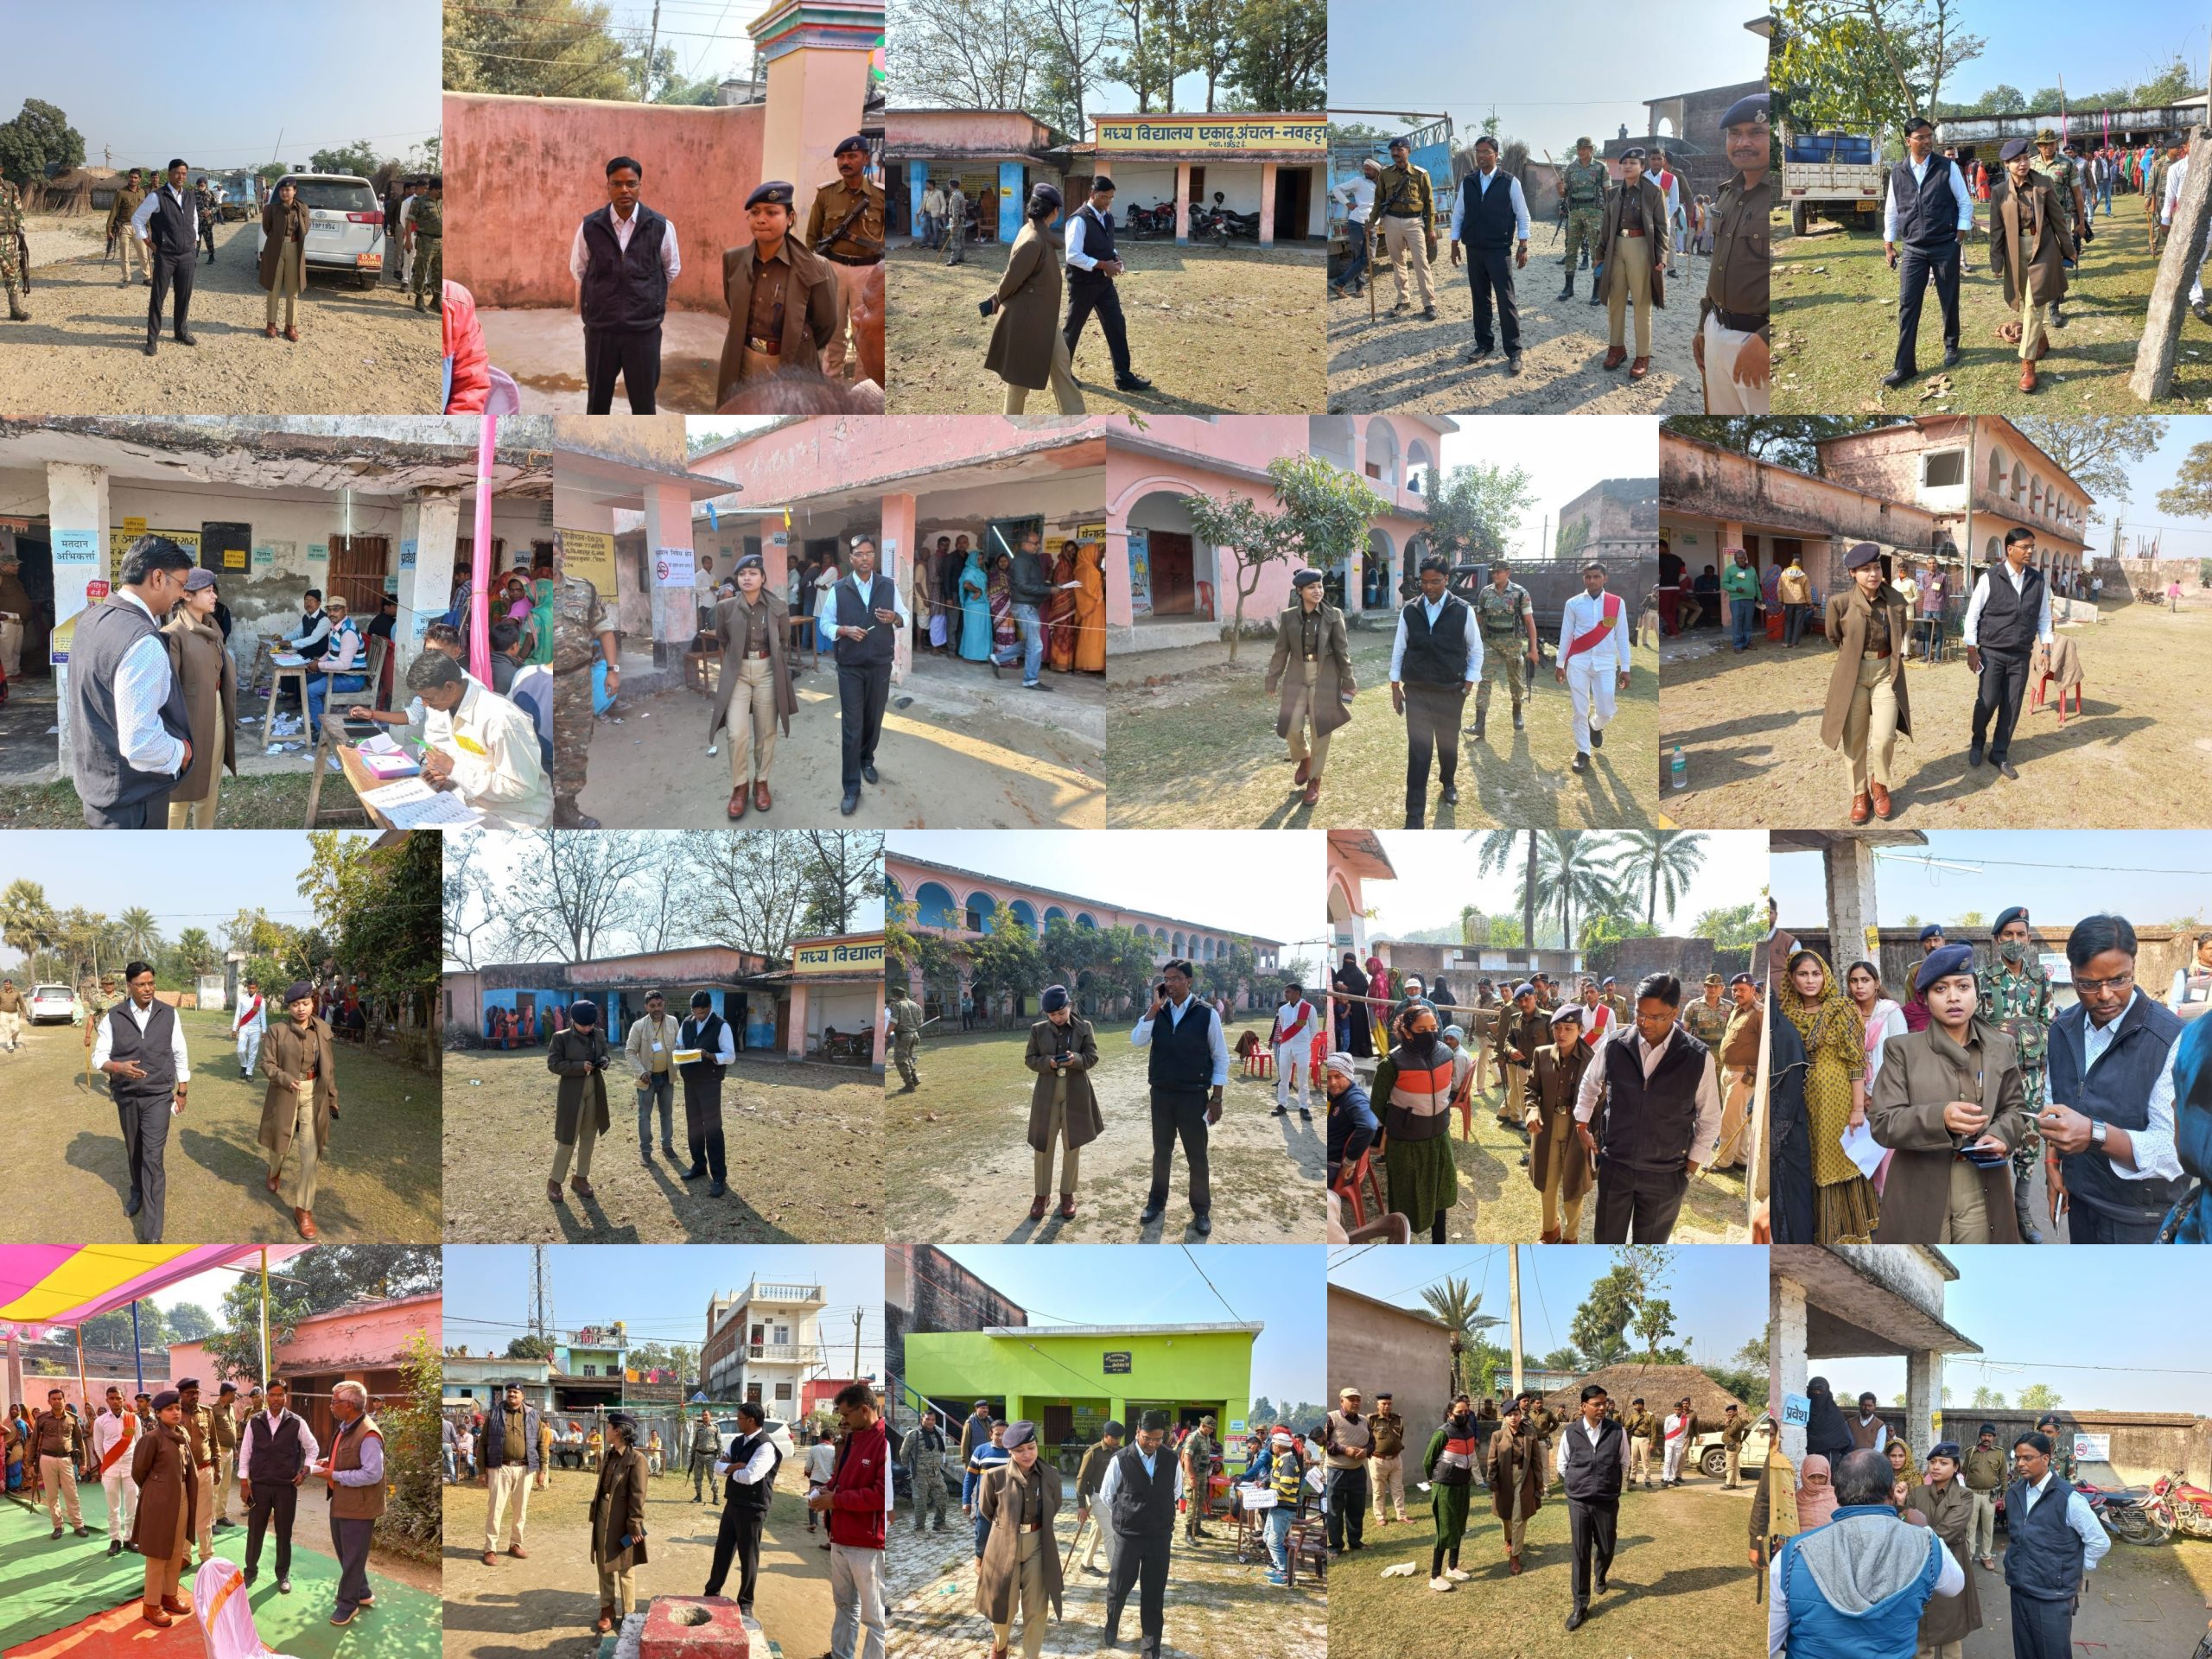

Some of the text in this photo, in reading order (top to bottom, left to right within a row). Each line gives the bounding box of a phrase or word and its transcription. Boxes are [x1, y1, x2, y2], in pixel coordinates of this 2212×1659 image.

[1103, 127, 1132, 140] मध्य
[1136, 124, 1194, 141] विद्यालय
[61, 539, 89, 549] मतदान
[400, 550, 416, 566] प्रवेश
[800, 944, 885, 963] मध्य विद्याल
[1786, 1404, 1808, 1422] प्रवेश
